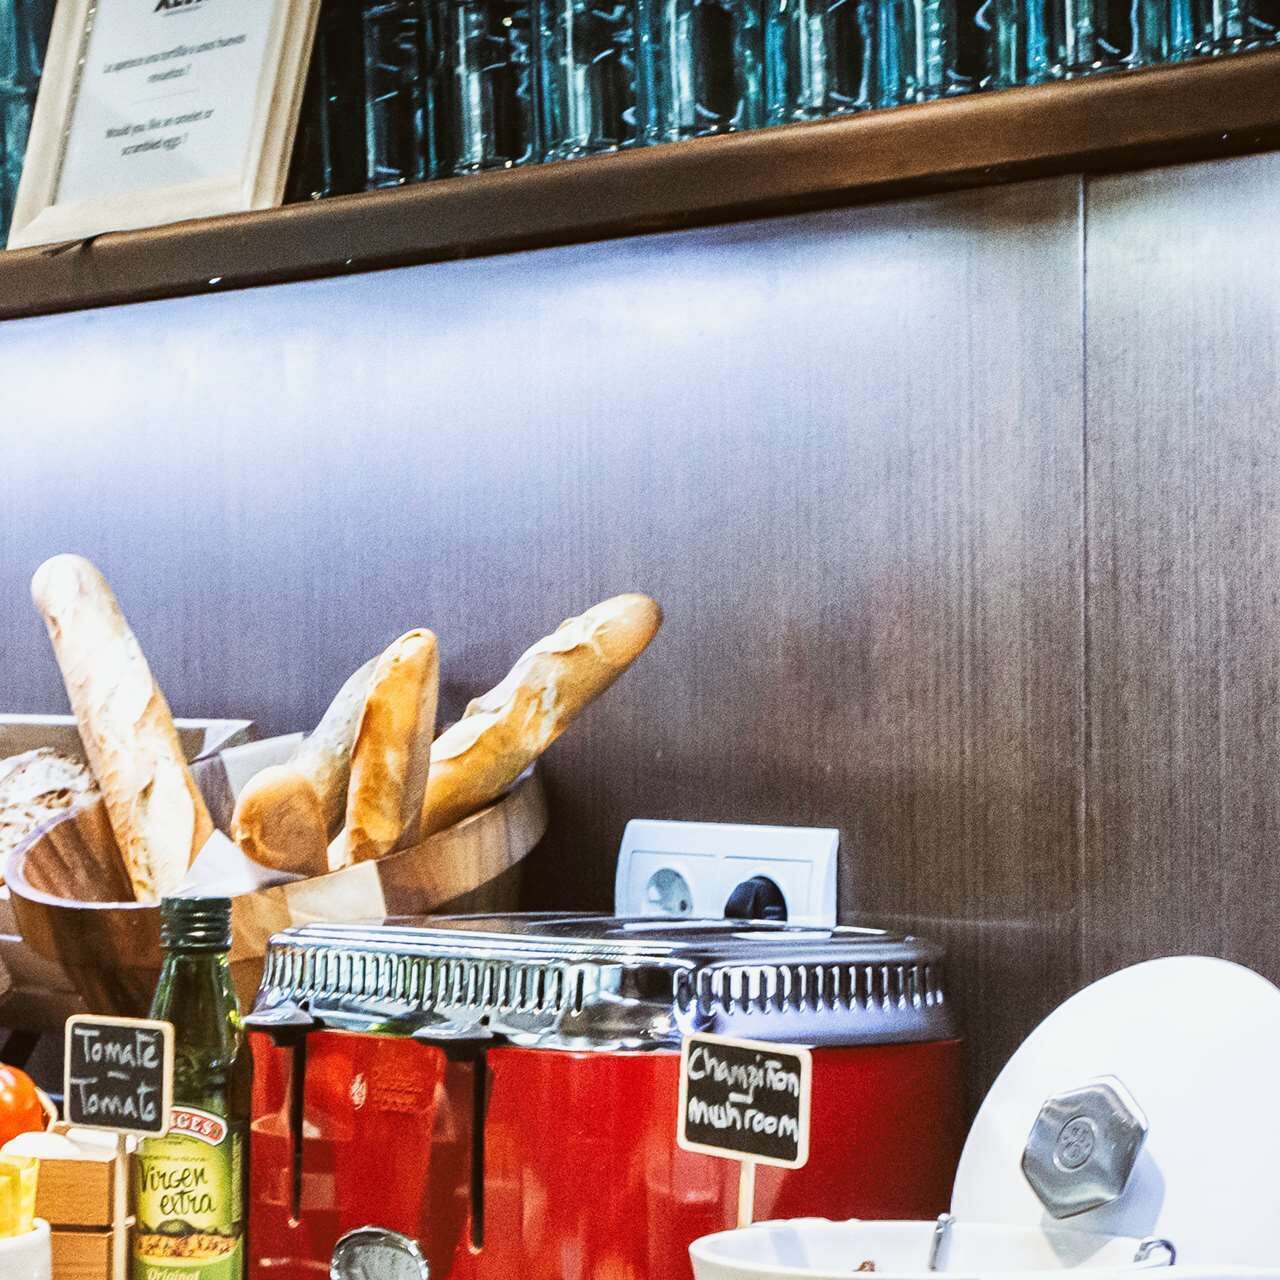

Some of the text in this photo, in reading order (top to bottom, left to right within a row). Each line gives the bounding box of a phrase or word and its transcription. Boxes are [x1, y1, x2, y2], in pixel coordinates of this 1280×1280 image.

[71, 1077, 156, 1122] Tomato
[140, 1163, 209, 1193] Virgen
[159, 1189, 217, 1216] extra
